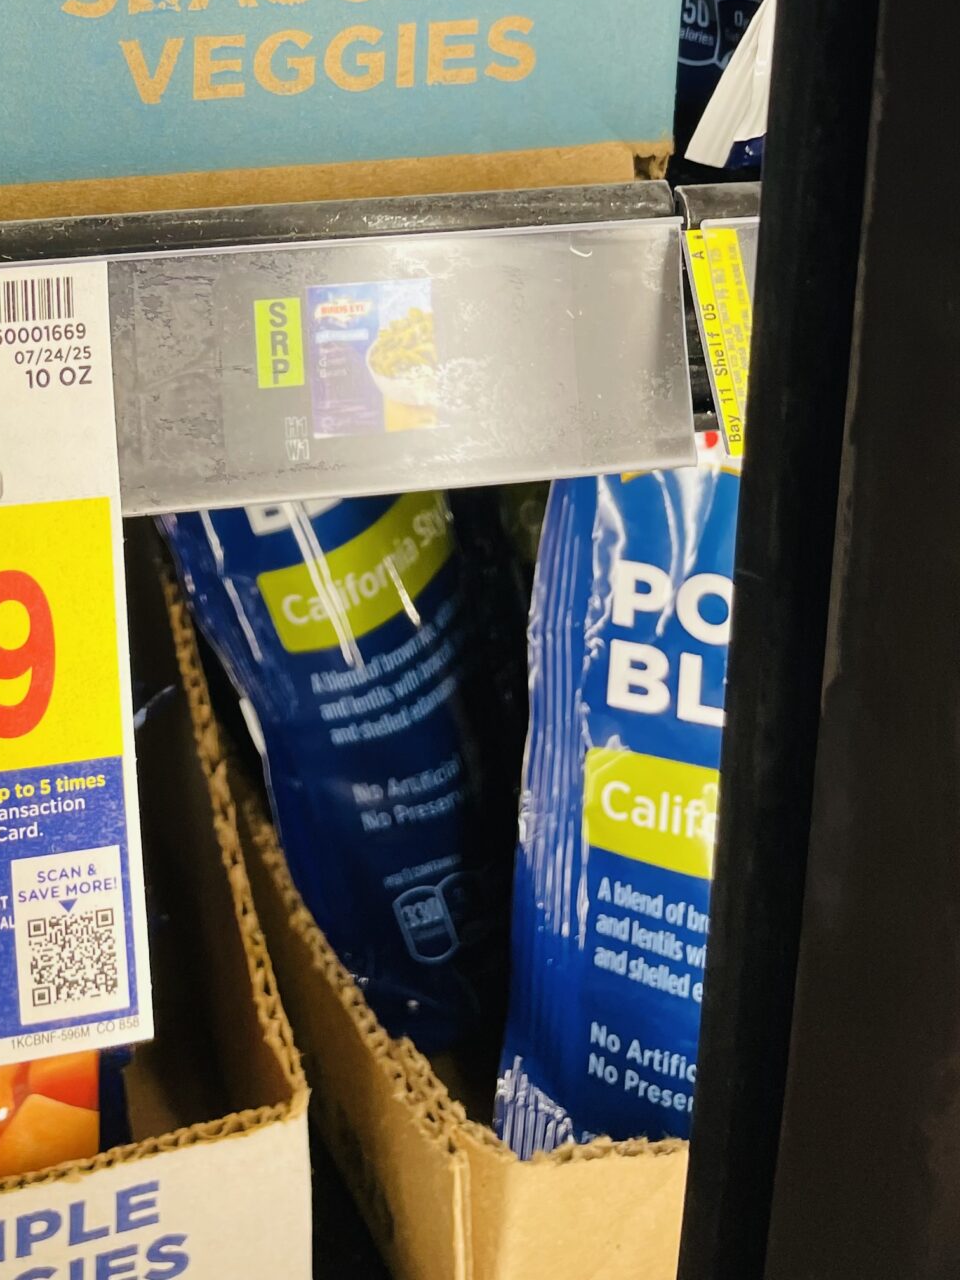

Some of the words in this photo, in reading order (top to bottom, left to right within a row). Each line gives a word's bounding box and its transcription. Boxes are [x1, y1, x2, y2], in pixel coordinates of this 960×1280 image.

[118, 15, 536, 105] VEGGIES
[702, 303, 716, 321] 05
[14, 346, 92, 366] 07/24/25
[708, 331, 728, 377] Shelf
[25, 368, 50, 390] 10
[59, 364, 93, 387] OZ
[729, 414, 742, 443] Bay
[612, 559, 733, 645] PO
[606, 638, 726, 727] BL
[14, 783, 35, 800] to
[40, 778, 51, 795] 5
[55, 774, 106, 793] times
[36, 865, 82, 883] SCAN
[87, 863, 98, 876] &
[18, 885, 60, 903] SAVE
[65, 877, 118, 897] MORE!
[597, 877, 612, 902] A
[613, 881, 664, 920] blend
[665, 901, 687, 927] of
[595, 914, 630, 942] and
[631, 920, 684, 961] lentils
[594, 946, 628, 976] and
[628, 957, 691, 998] shelled
[590, 1021, 621, 1053] No
[587, 1052, 618, 1085] No
